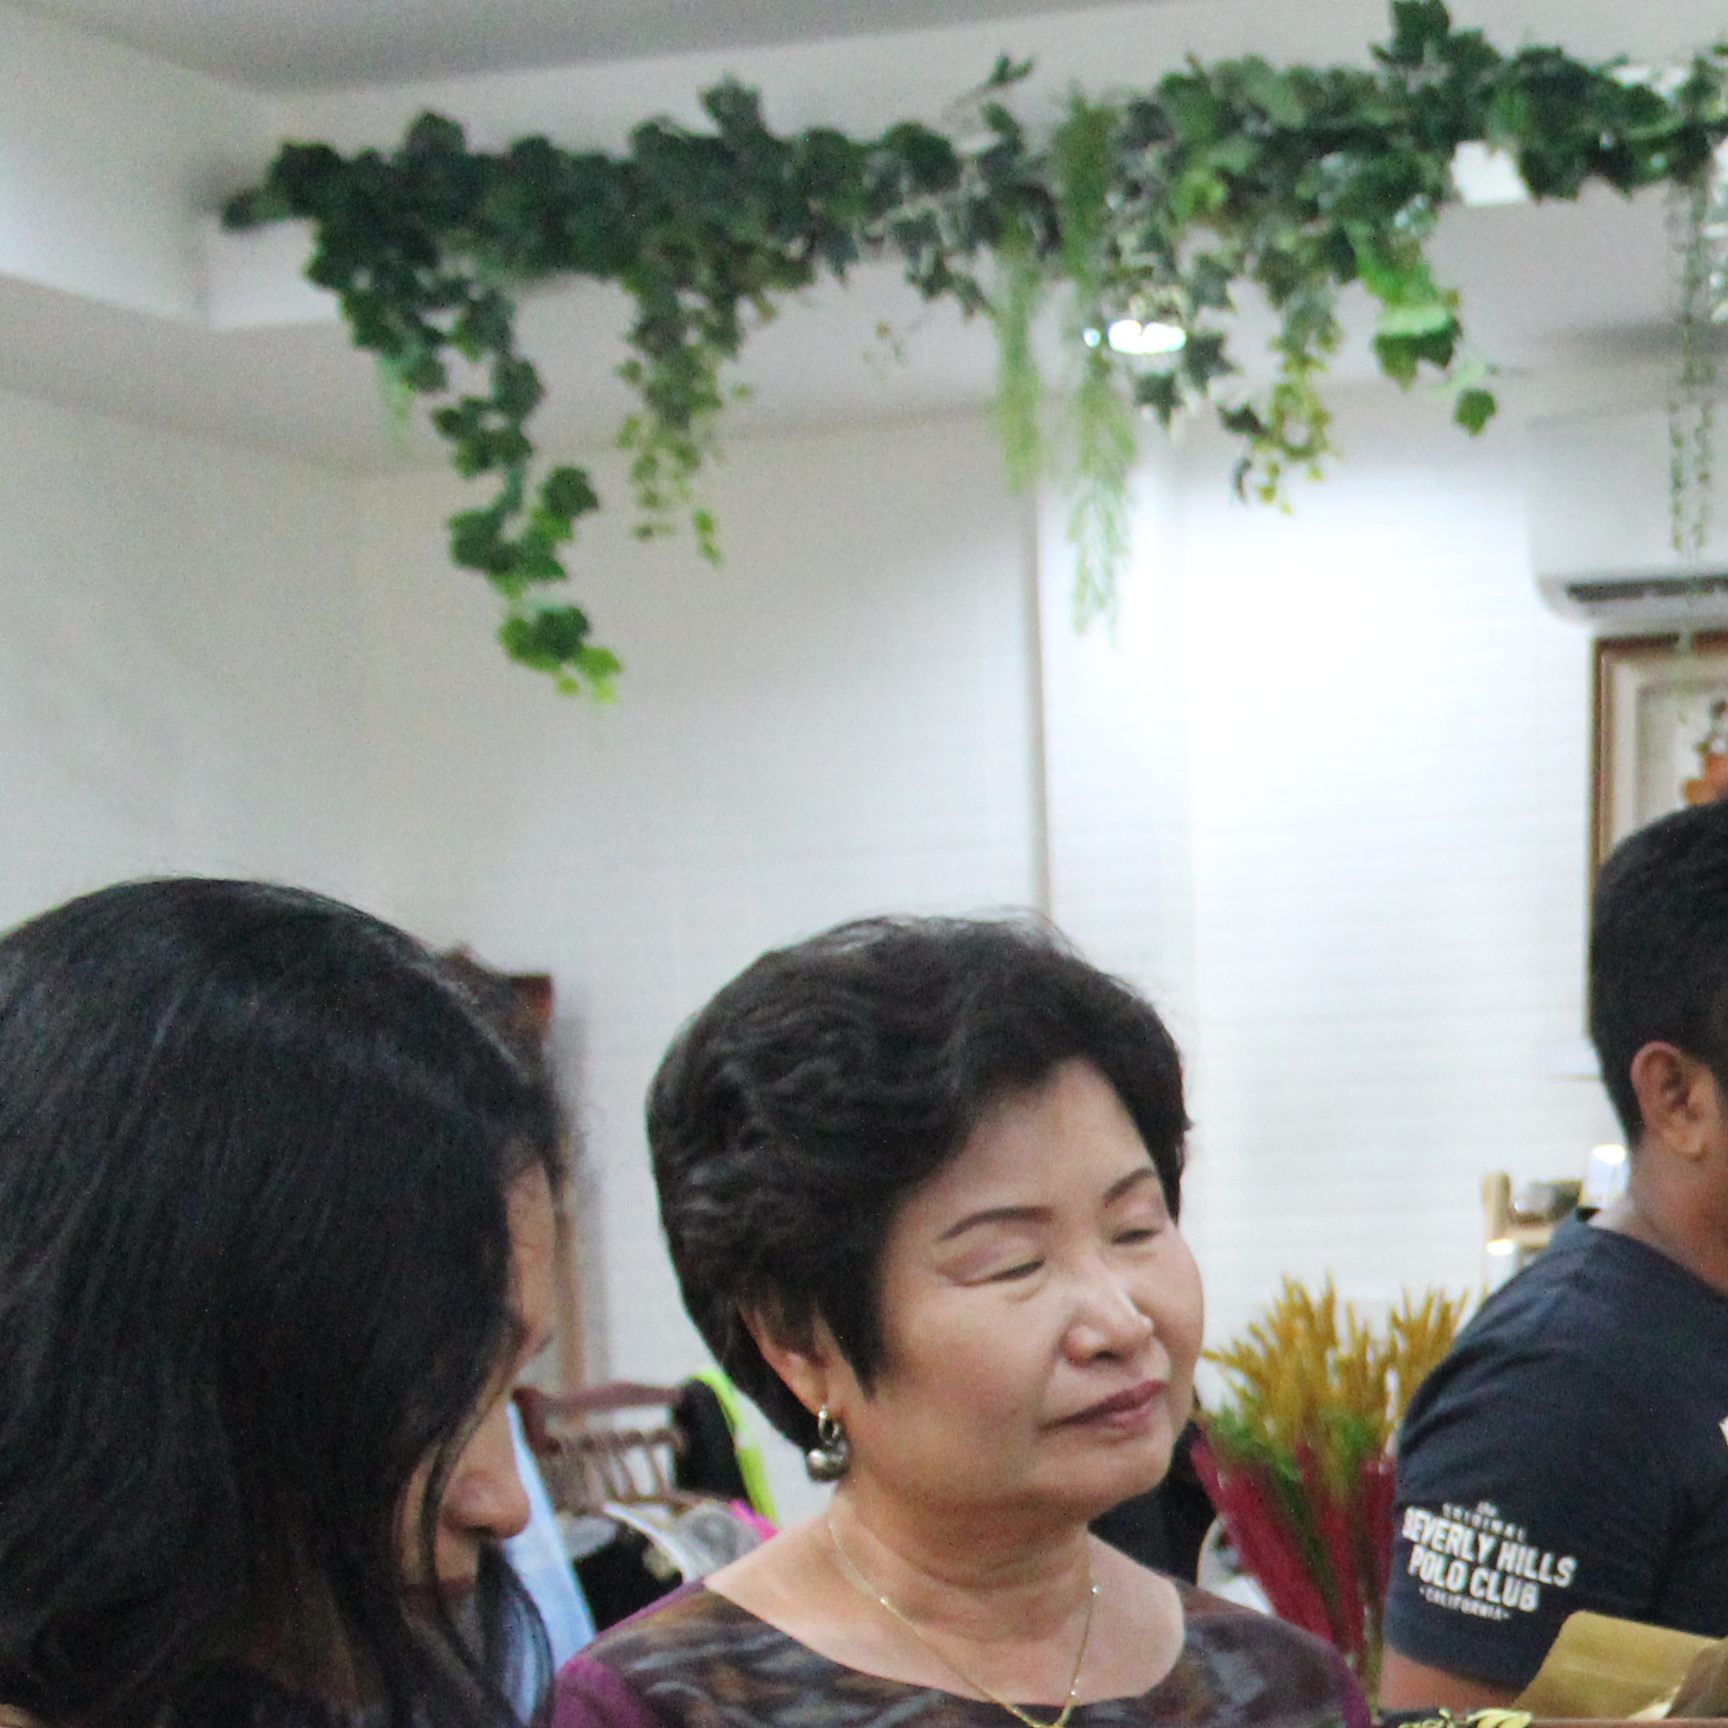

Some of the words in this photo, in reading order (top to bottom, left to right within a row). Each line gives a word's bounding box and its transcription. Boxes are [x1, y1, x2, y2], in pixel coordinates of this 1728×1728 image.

[1402, 1505, 1497, 1564] BEVERLY
[1497, 1540, 1578, 1588] HILLS
[1407, 1544, 1469, 1593] POLO
[1470, 1566, 1540, 1612] CLUB
